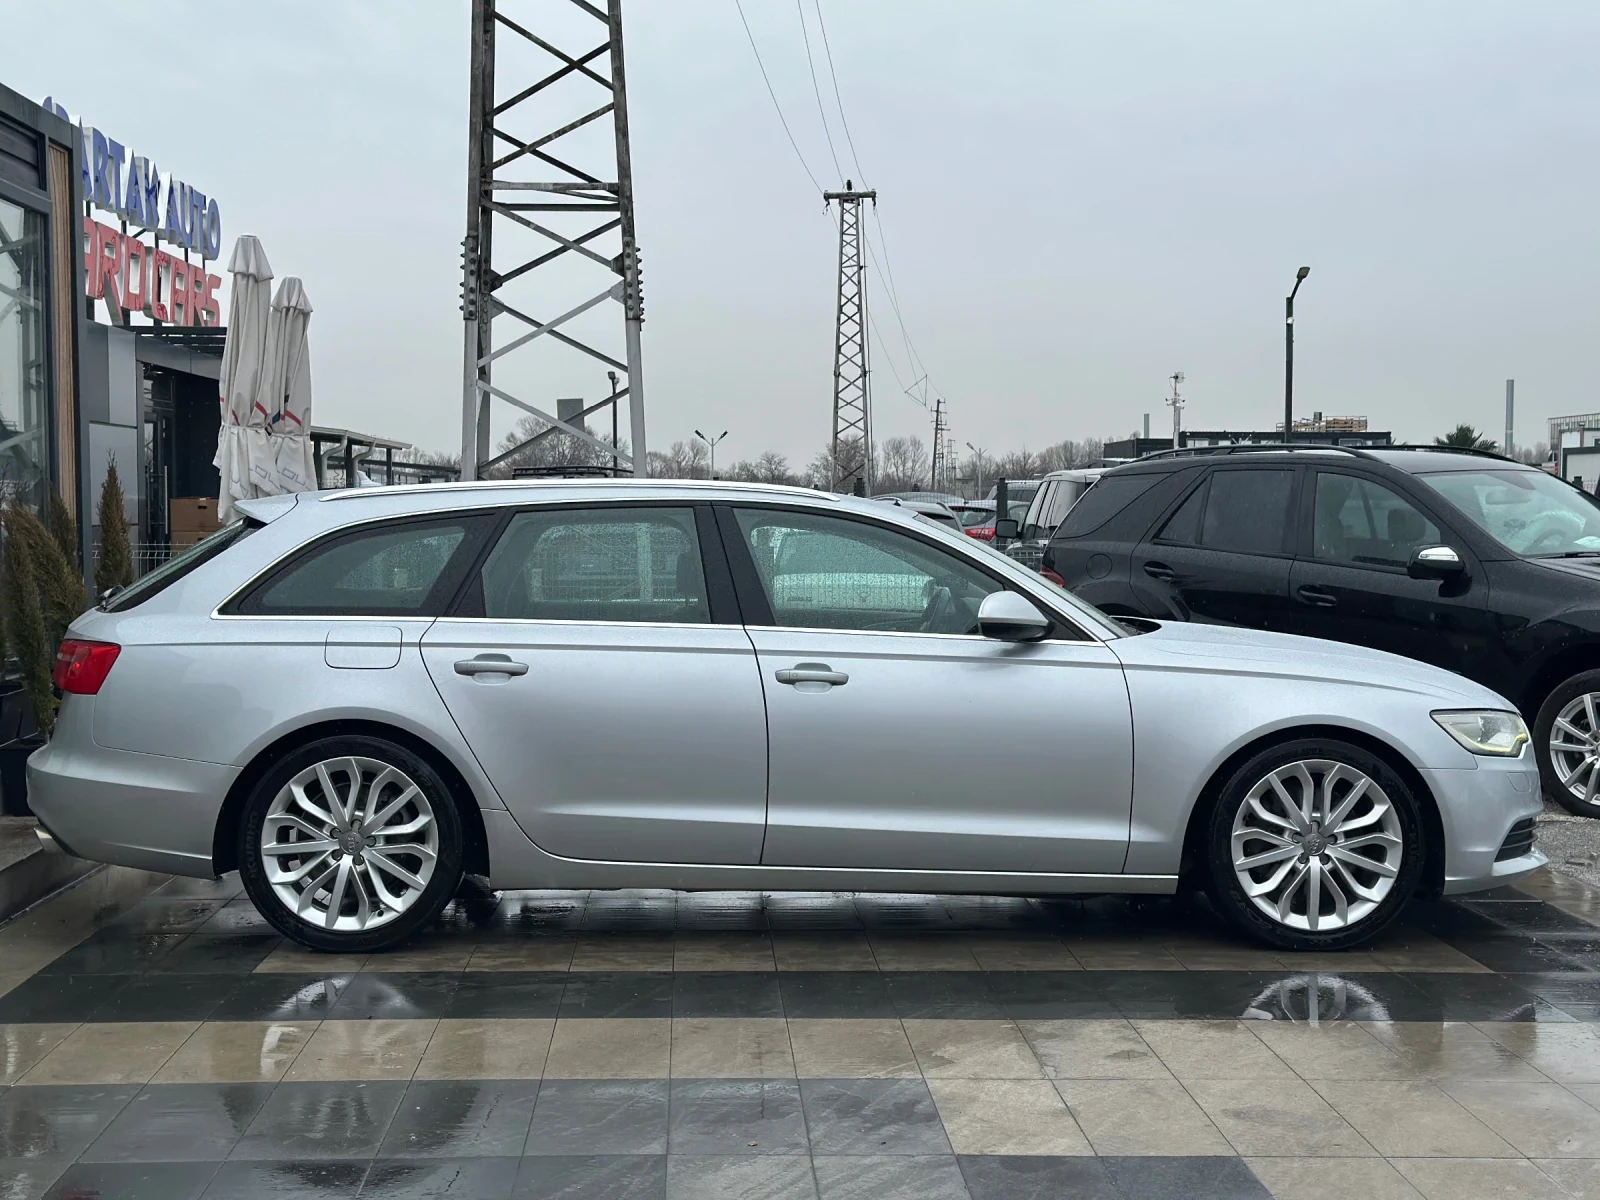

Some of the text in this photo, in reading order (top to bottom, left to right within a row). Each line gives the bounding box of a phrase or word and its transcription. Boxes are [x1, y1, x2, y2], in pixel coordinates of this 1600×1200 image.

[160, 173, 221, 261] AUTO
[151, 249, 222, 327] CARS
[245, 811, 260, 872] KUMHO
